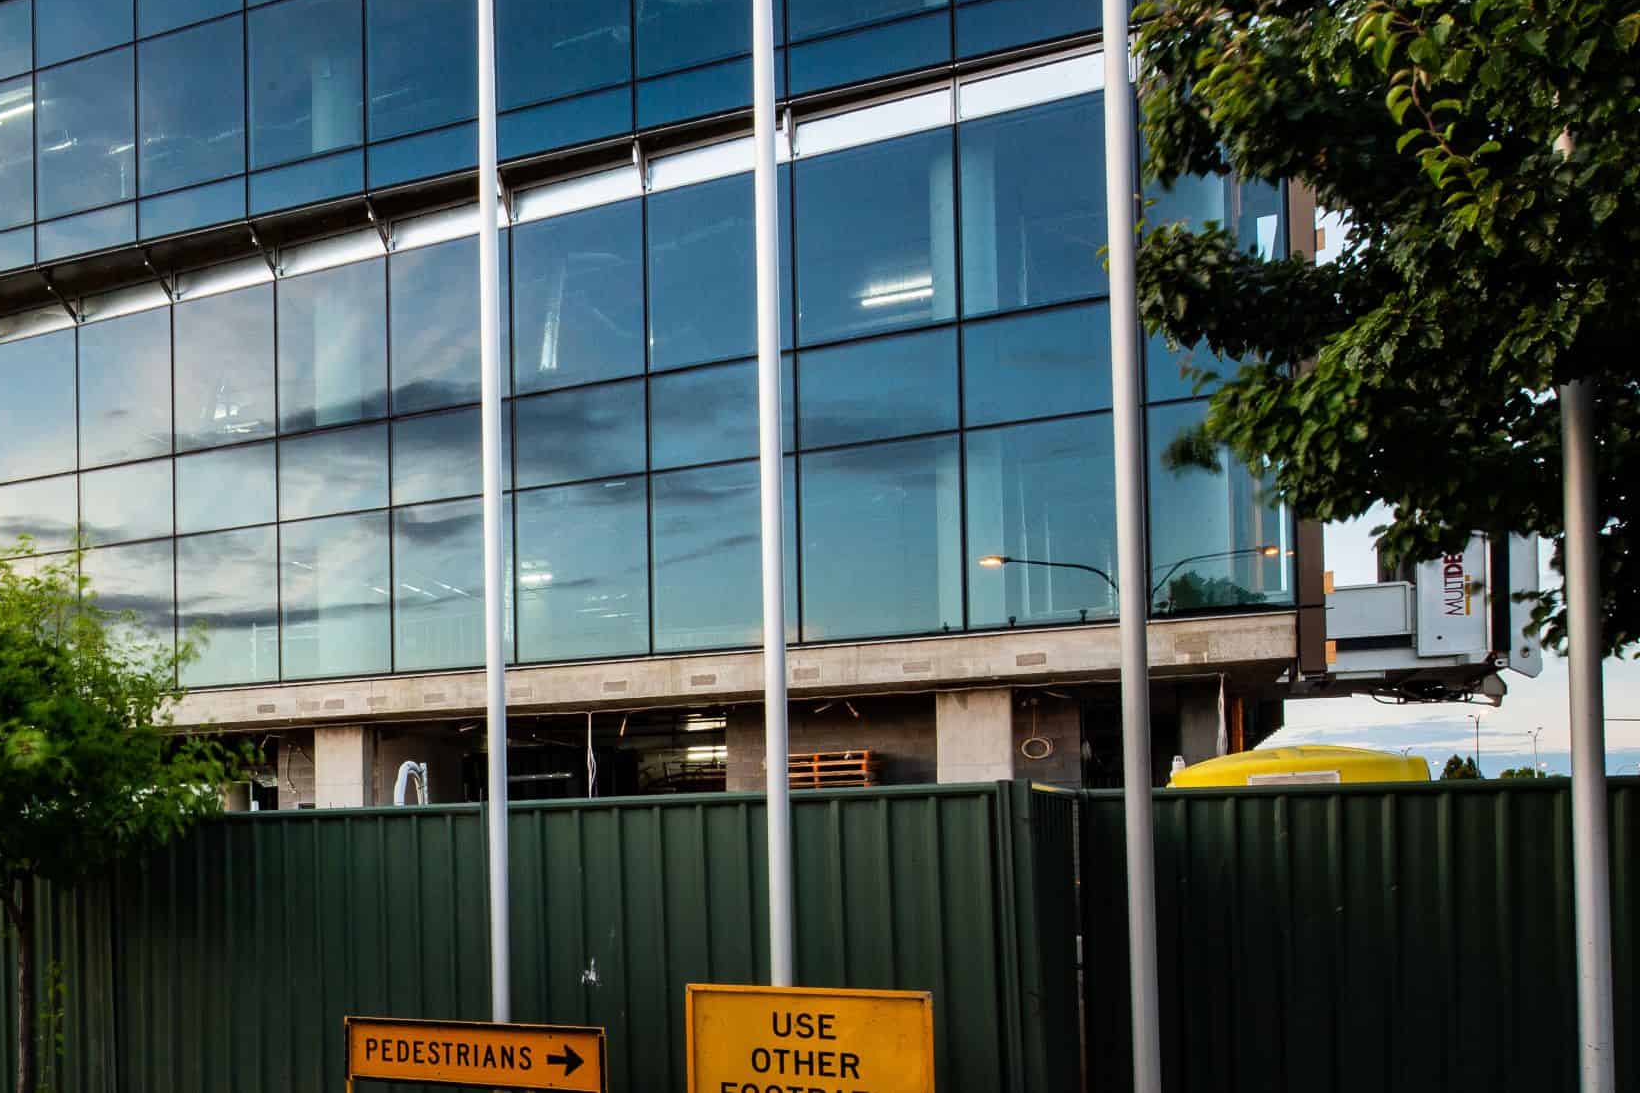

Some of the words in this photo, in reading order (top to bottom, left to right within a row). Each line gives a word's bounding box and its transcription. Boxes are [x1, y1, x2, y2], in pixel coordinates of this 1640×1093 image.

[1443, 554, 1464, 615] MULTIDE
[772, 1011, 837, 1040] USE
[365, 1038, 533, 1070] PEDESTRIANS
[752, 1048, 860, 1079] OTHER
